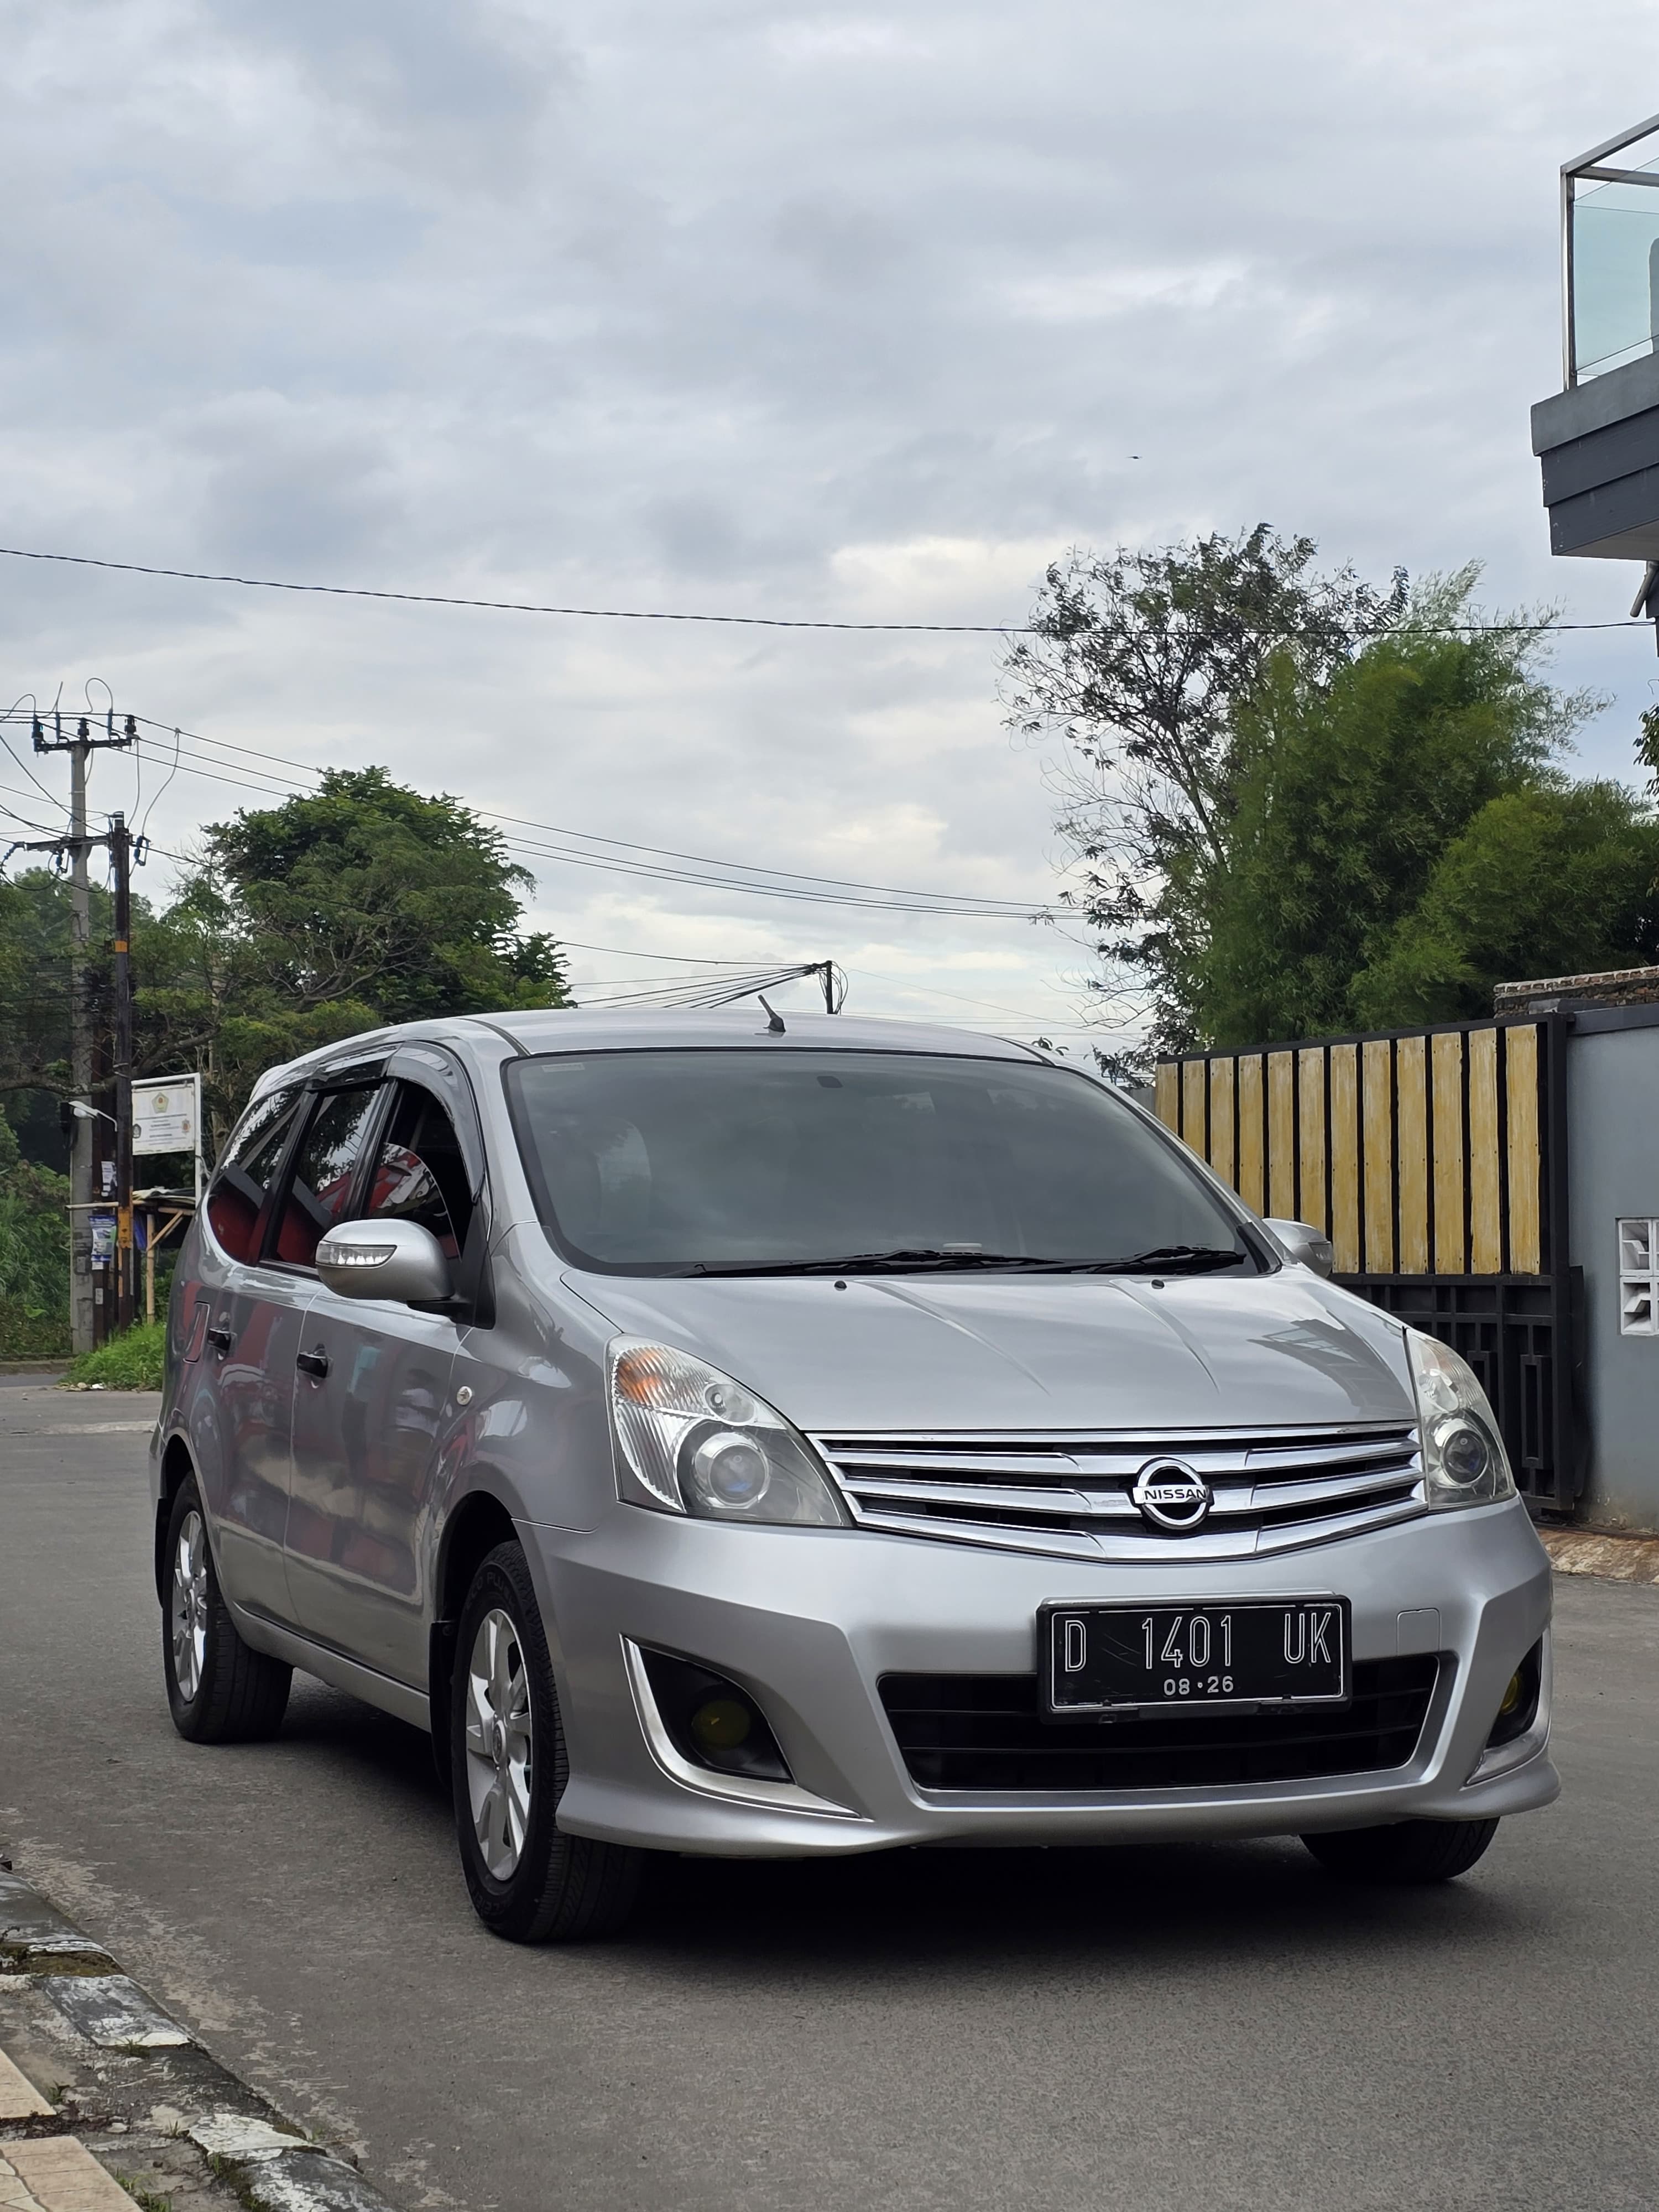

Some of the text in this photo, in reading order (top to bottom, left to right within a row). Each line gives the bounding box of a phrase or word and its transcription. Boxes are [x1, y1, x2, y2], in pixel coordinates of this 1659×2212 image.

[1144, 1489, 1207, 1500] NISSAN
[1064, 1611, 1332, 1672] D 1401 UK
